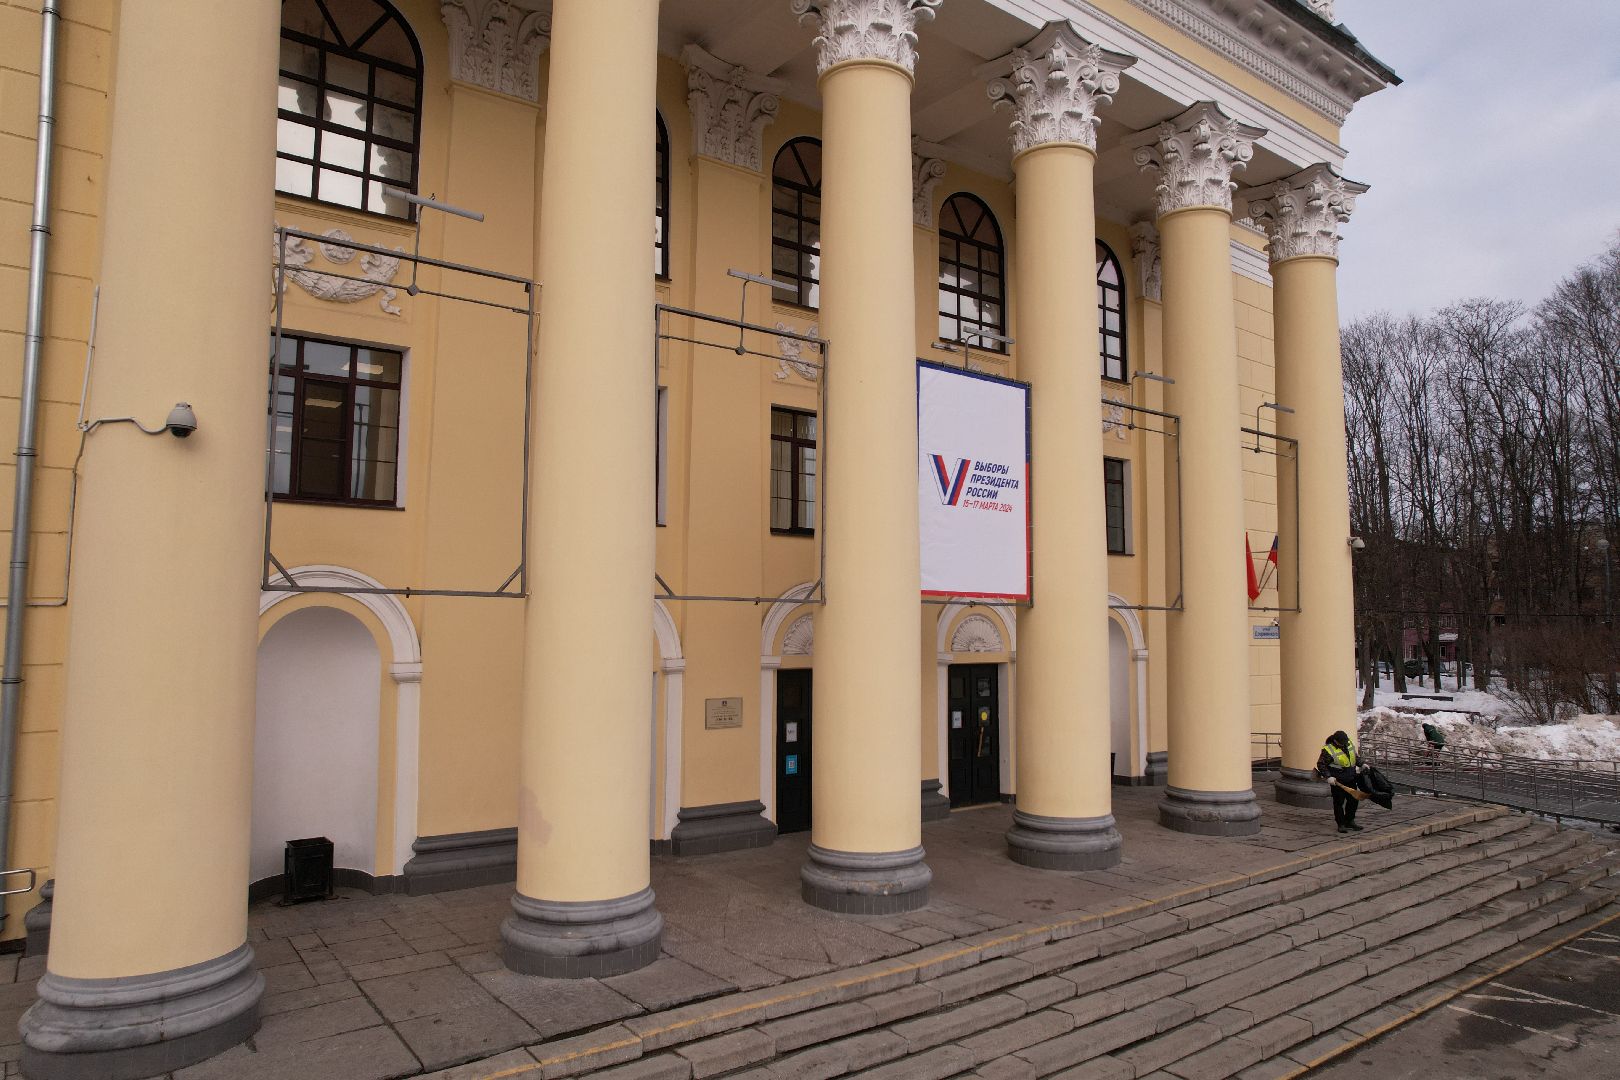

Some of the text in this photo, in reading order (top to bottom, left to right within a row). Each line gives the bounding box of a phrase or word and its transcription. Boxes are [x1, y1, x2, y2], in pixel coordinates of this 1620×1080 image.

[974, 461, 1009, 474] ВЫБОРЫ
[970, 474, 1019, 489] ПРЕЗИДЕНТА
[966, 487, 998, 499] РОССИИ
[979, 501, 998, 511] МАРТА
[998, 503, 1013, 512] 2024
